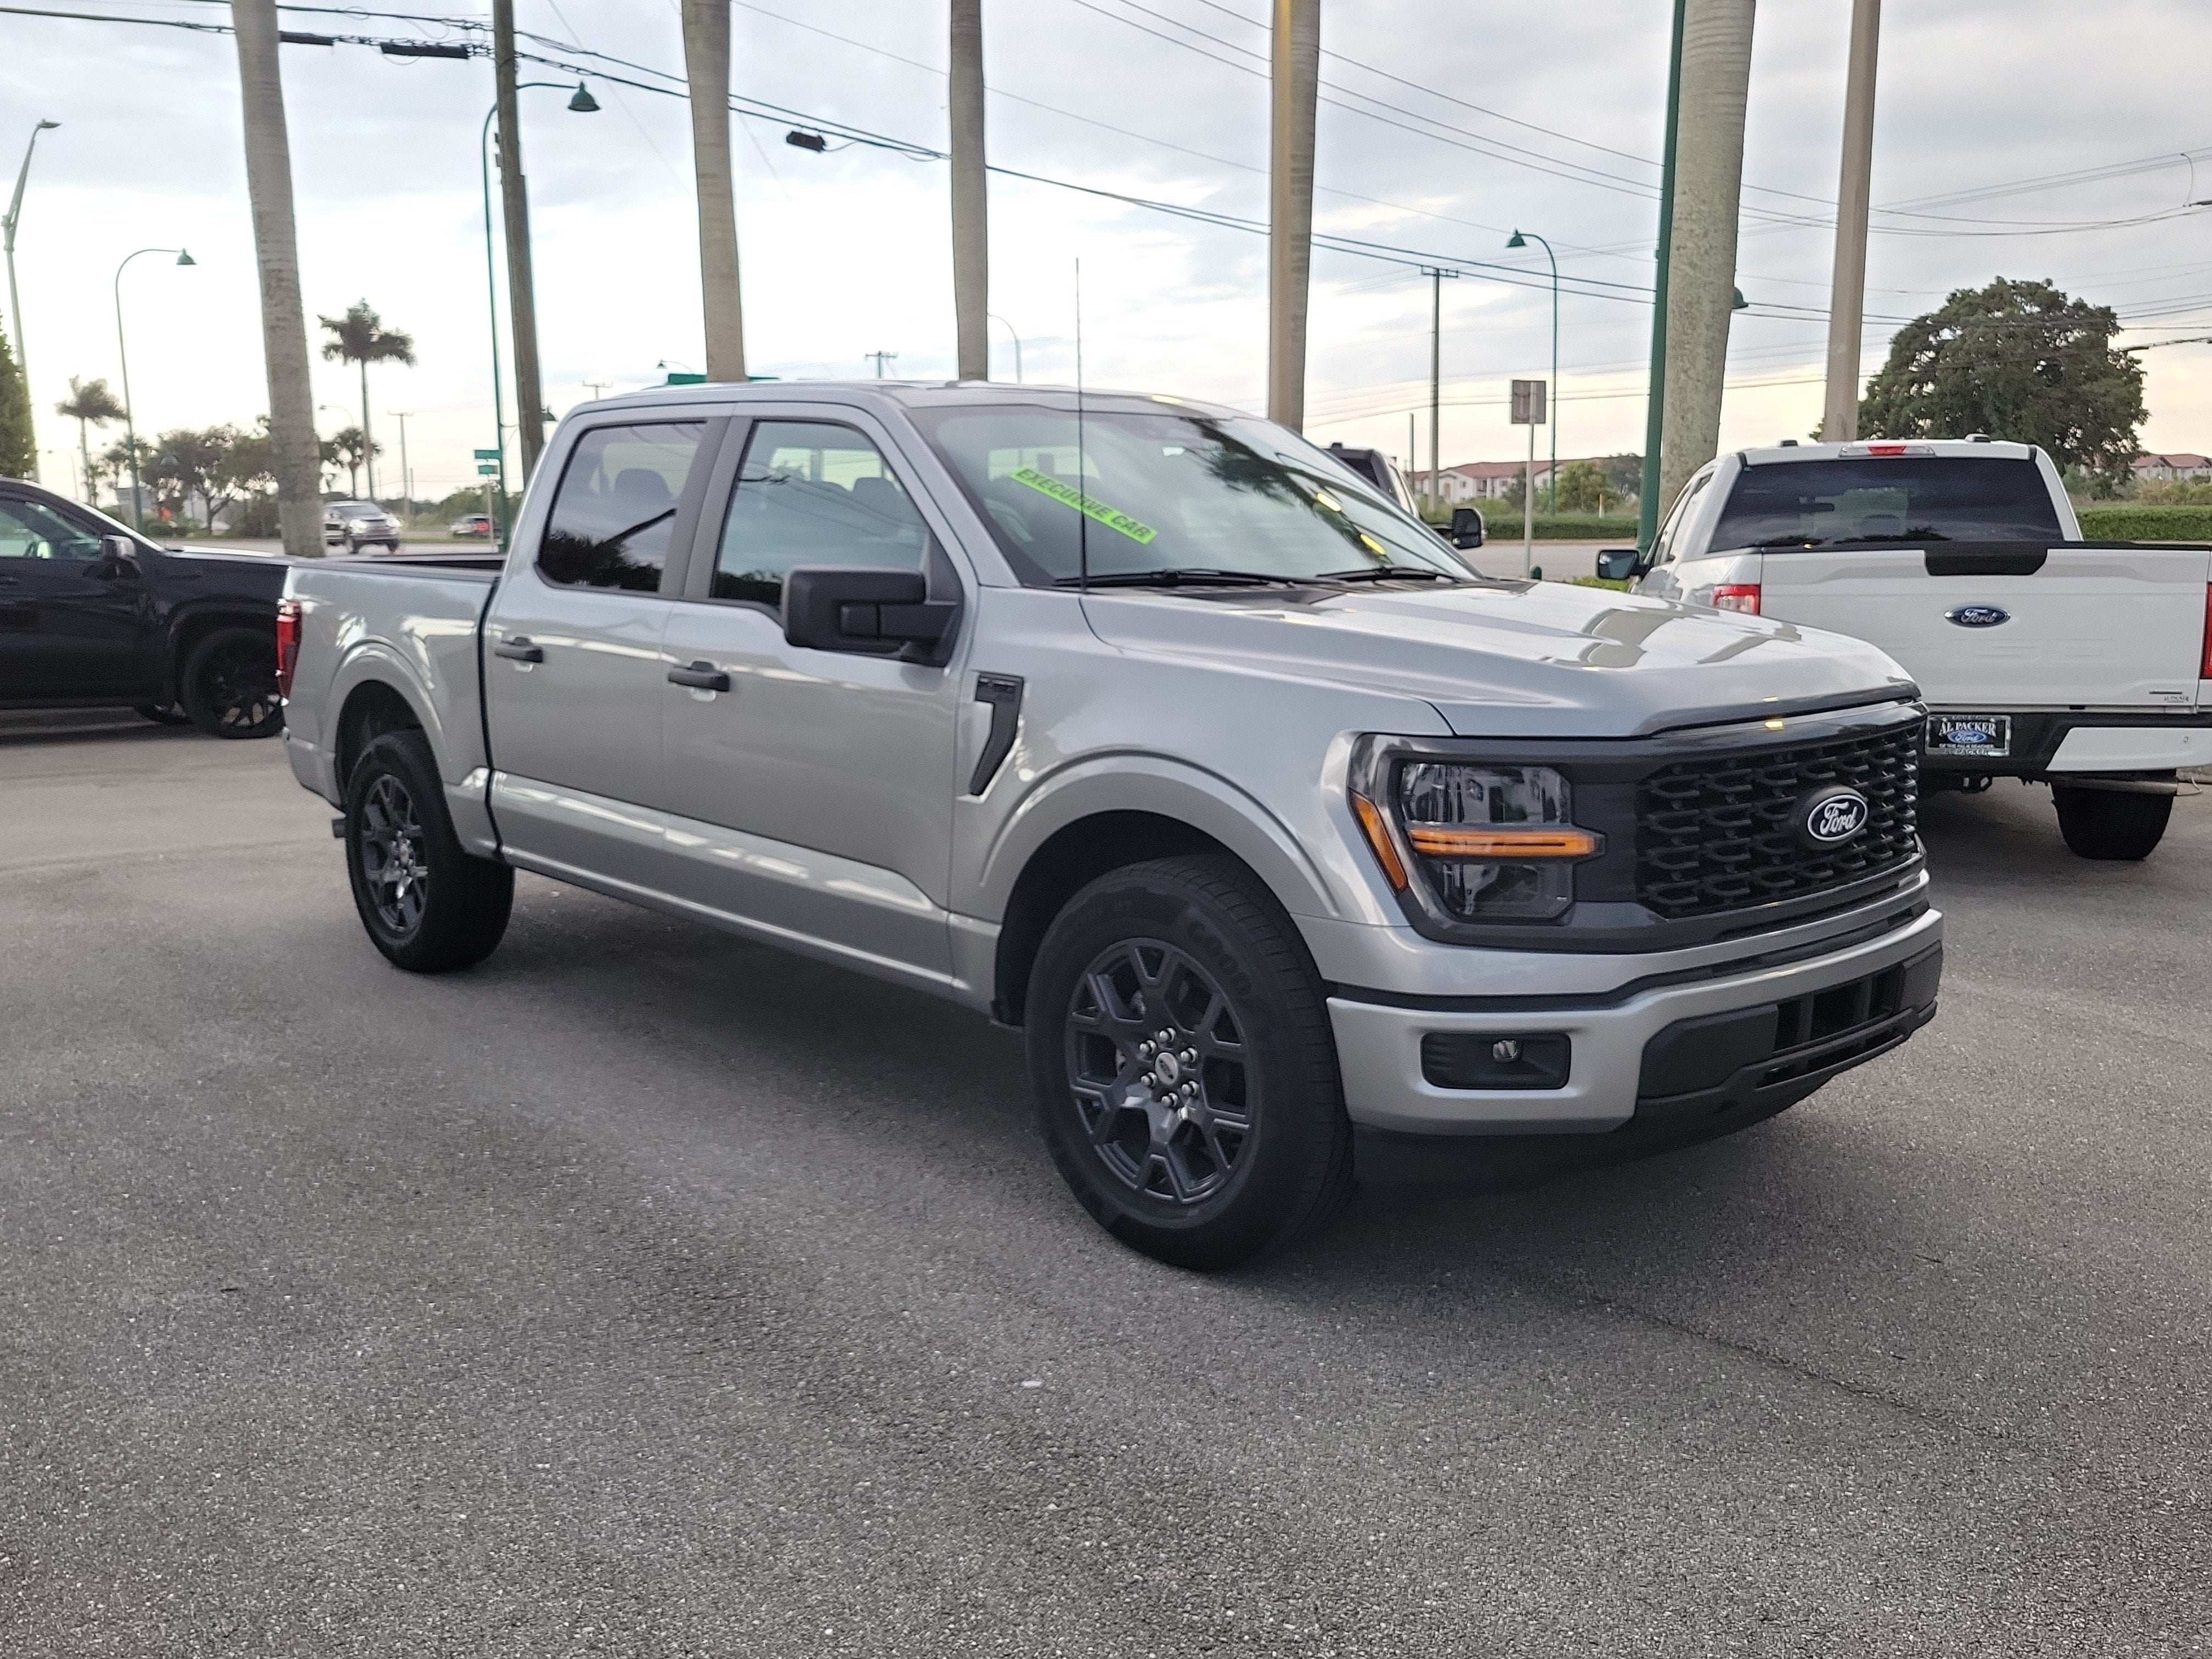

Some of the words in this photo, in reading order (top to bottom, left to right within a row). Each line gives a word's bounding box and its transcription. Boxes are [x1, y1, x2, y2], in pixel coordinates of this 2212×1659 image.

[1016, 468, 1113, 517] EXECUTIVE
[1111, 515, 1152, 537] CAR
[1961, 608, 1996, 623] Ford
[1939, 722, 1953, 737] AL
[1955, 722, 1997, 737] PACKER
[1954, 731, 1980, 742] Ford
[1820, 802, 1858, 836] Ford
